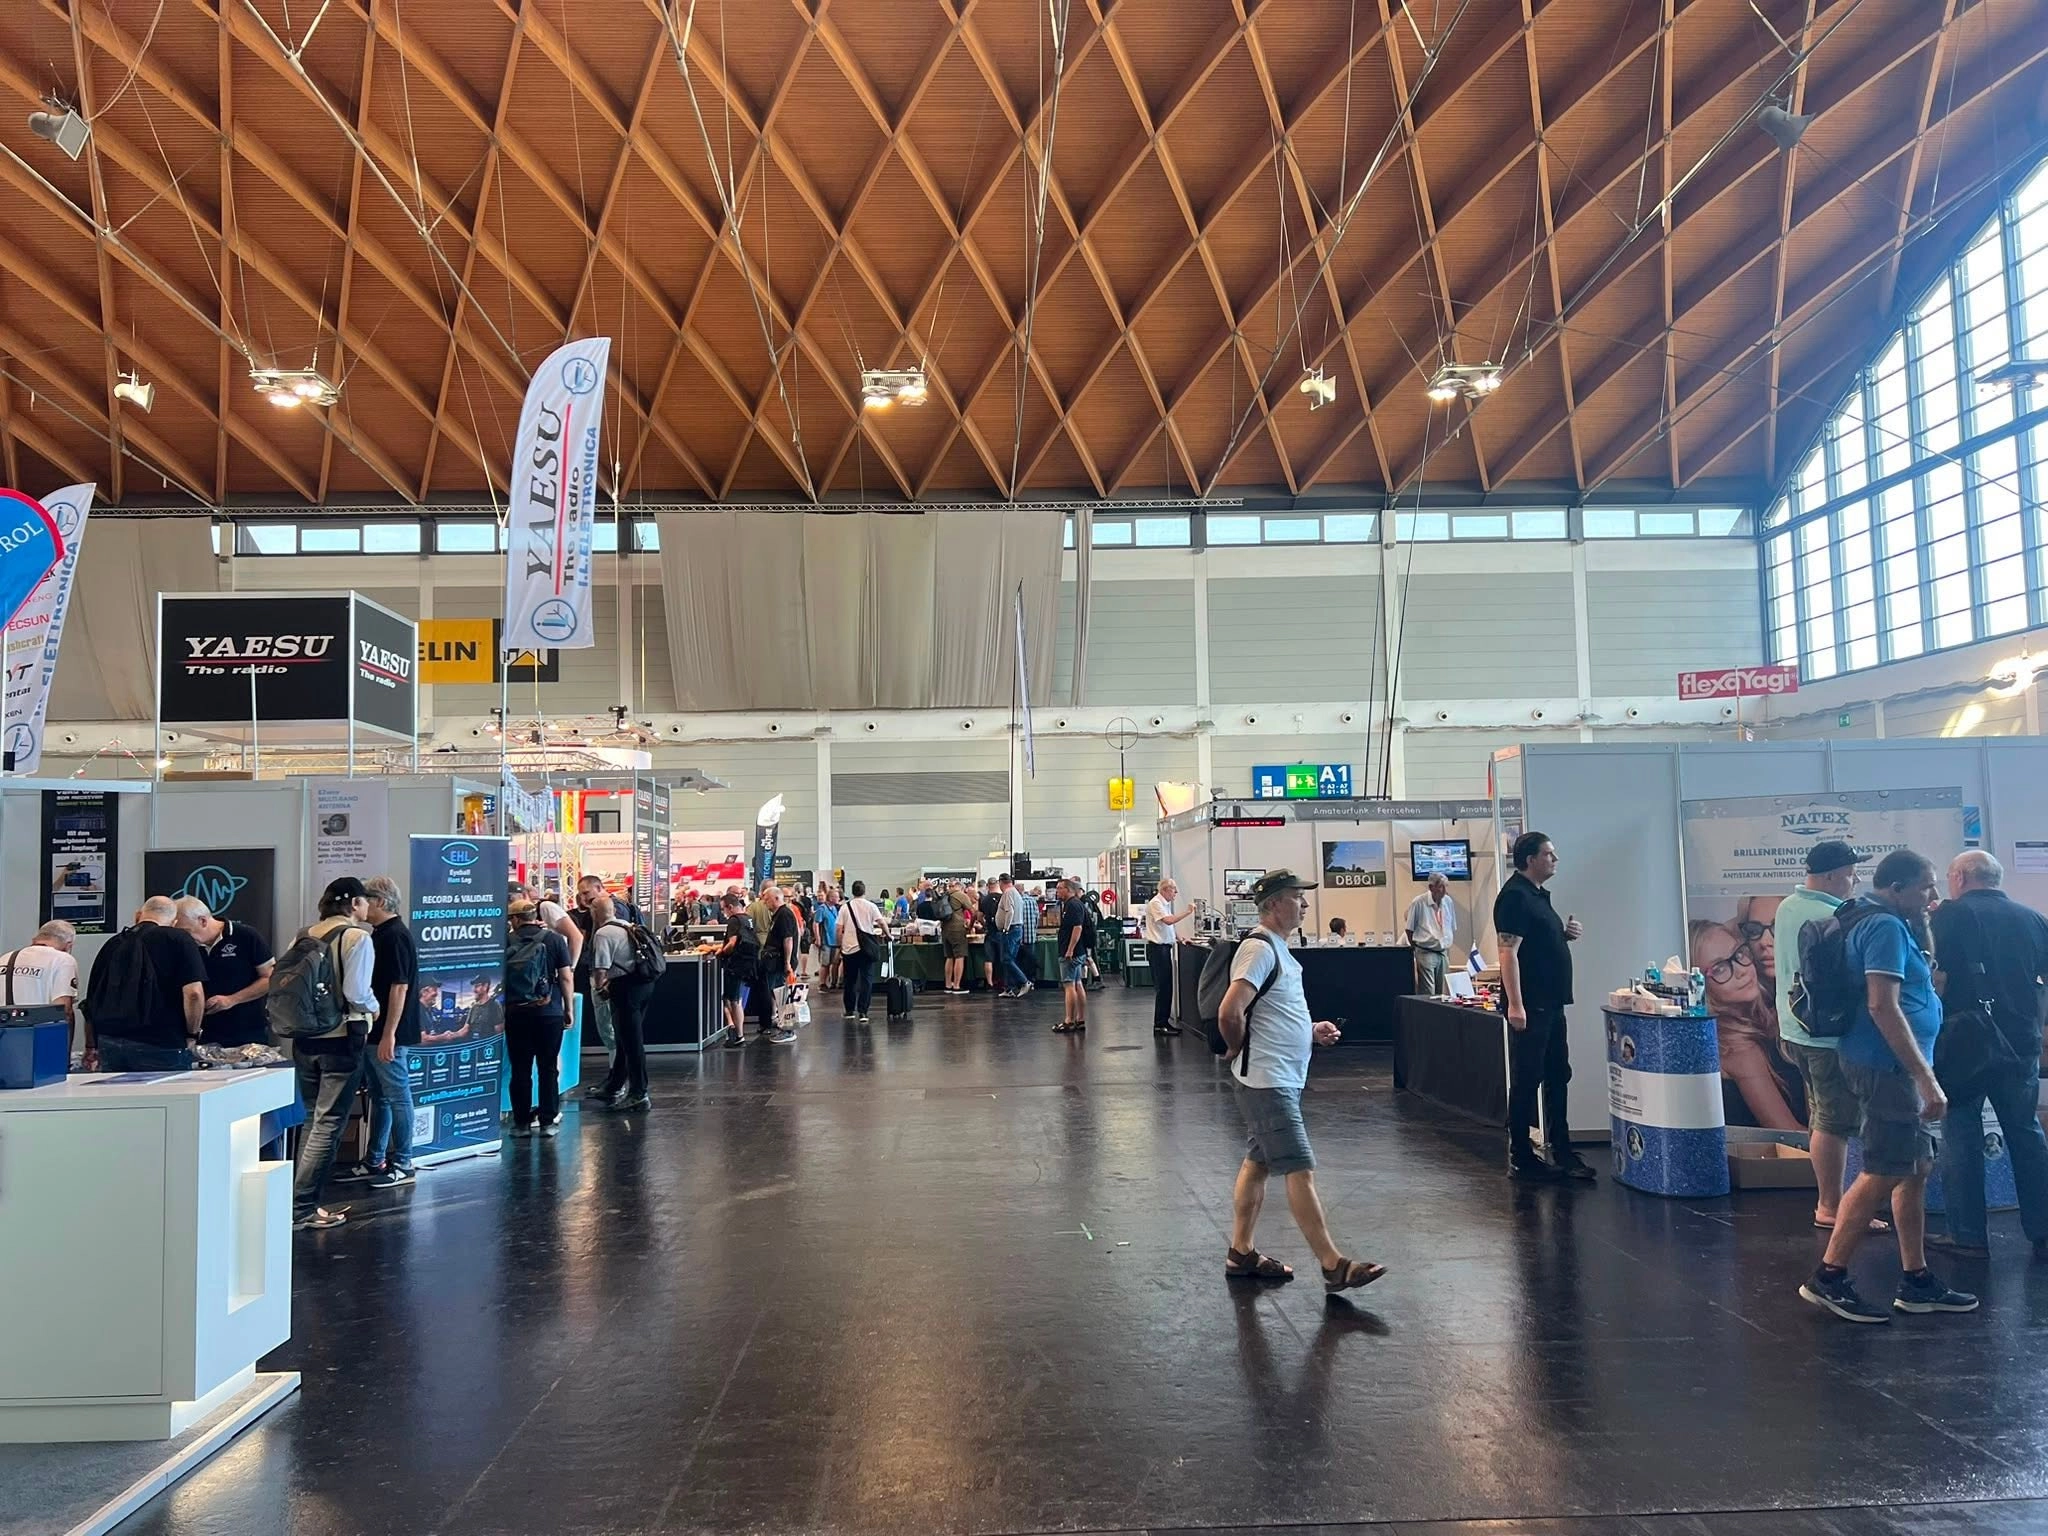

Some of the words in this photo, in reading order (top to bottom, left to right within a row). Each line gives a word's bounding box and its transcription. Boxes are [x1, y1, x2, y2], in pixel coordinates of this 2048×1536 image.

[526, 402, 563, 580] YAESU
[0, 521, 44, 557] ROL
[563, 539, 576, 587] The
[185, 635, 334, 658] YAESU
[359, 640, 411, 678] YAESU
[185, 665, 223, 675] The
[232, 665, 288, 675] radio
[359, 668, 375, 681] The
[376, 675, 396, 689] radio
[1319, 765, 1348, 782] A1
[1313, 805, 1370, 817] Amateurfunk
[1378, 806, 1421, 816] Fernsehen
[1460, 806, 1515, 814] Amateuunk
[1780, 812, 1850, 828] NATEX
[450, 850, 470, 862] EHL
[1774, 857, 1797, 866] UND
[763, 852, 772, 880] TECHNIK
[422, 895, 453, 904] RECORD
[454, 895, 460, 903] &
[461, 894, 494, 903] VALIDATE
[412, 909, 457, 920] IN-PERSON
[458, 908, 477, 918] HAM
[478, 908, 502, 918] RADIO
[421, 924, 493, 941] CONTACTS
